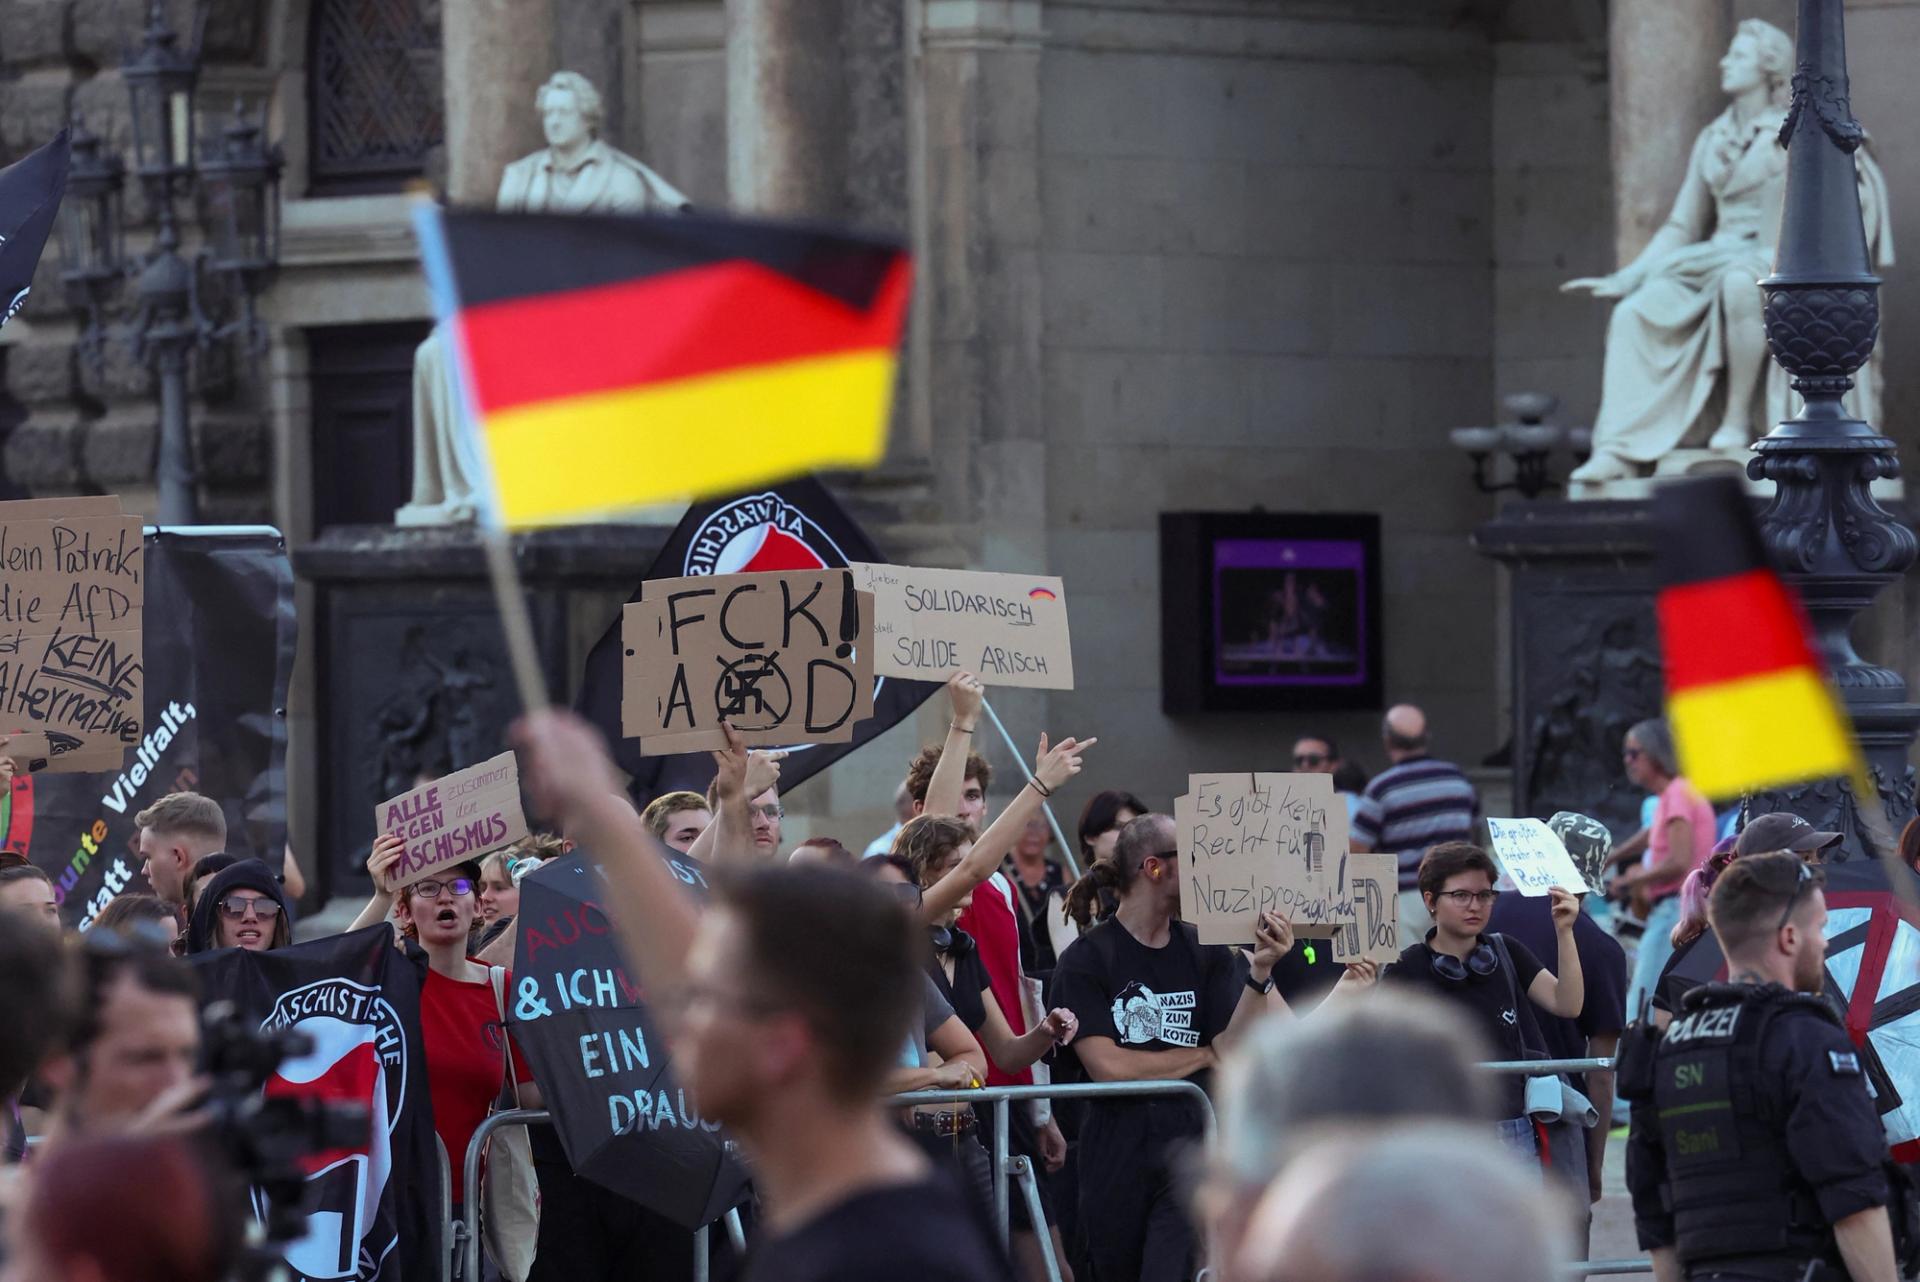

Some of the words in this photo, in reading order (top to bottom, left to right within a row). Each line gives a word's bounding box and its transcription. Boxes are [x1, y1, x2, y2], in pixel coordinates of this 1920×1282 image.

[52, 527, 140, 584] Patrick,
[60, 582, 130, 640] AfD
[668, 570, 860, 659] FCK!
[905, 585, 1033, 624] SOLIDARISCH
[893, 637, 961, 668] SOLIDE
[980, 646, 1048, 675] ARISCH
[102, 700, 197, 814] Vielfalt,
[387, 787, 442, 829] ALLE
[390, 809, 444, 842] EGEN
[1197, 782, 1222, 818] Es
[1230, 784, 1272, 826] gibt
[1193, 819, 1270, 858] Recht
[526, 901, 613, 962] AUC
[515, 976, 552, 1021] &
[555, 968, 618, 1009] ICH
[1160, 993, 1194, 1007] NAZIS
[1165, 1012, 1189, 1025] ZUM
[579, 1027, 650, 1078] EIN
[1675, 1063, 1704, 1089] SN
